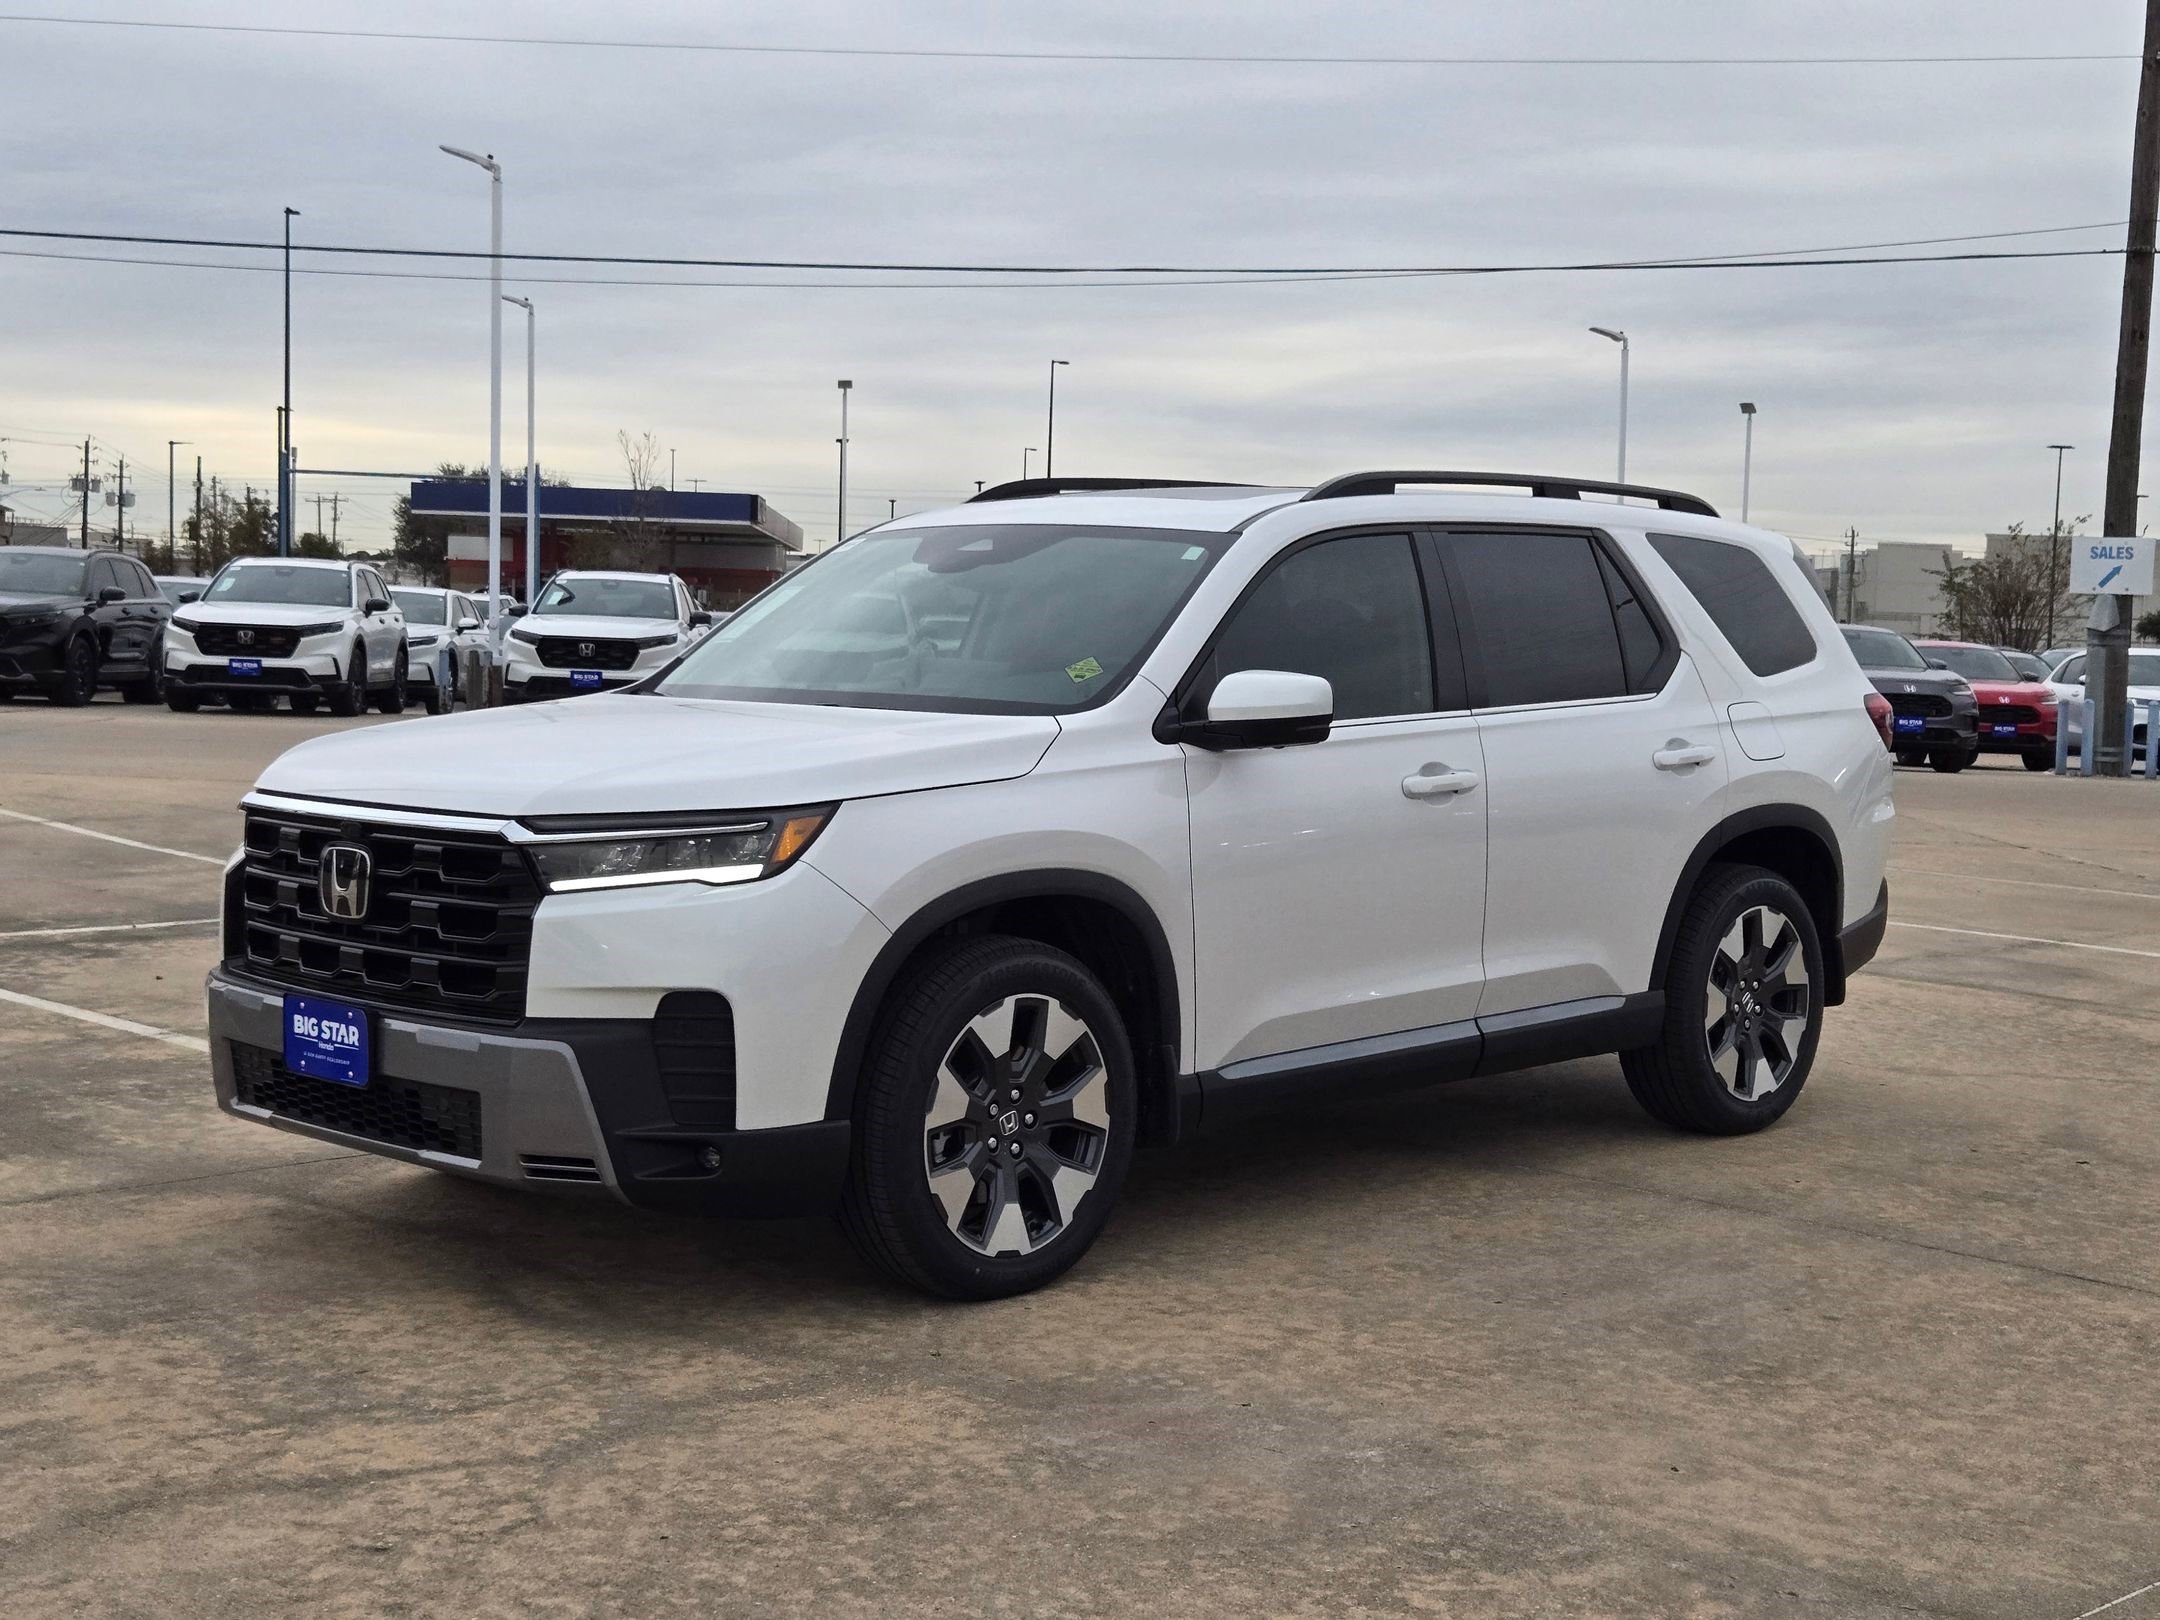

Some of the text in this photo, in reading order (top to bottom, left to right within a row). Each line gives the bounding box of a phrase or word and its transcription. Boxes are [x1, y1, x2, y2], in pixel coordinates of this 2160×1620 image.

[2090, 546, 2134, 560] SALES
[293, 1014, 360, 1047] BIG STAR
[318, 1040, 335, 1051] Honda
